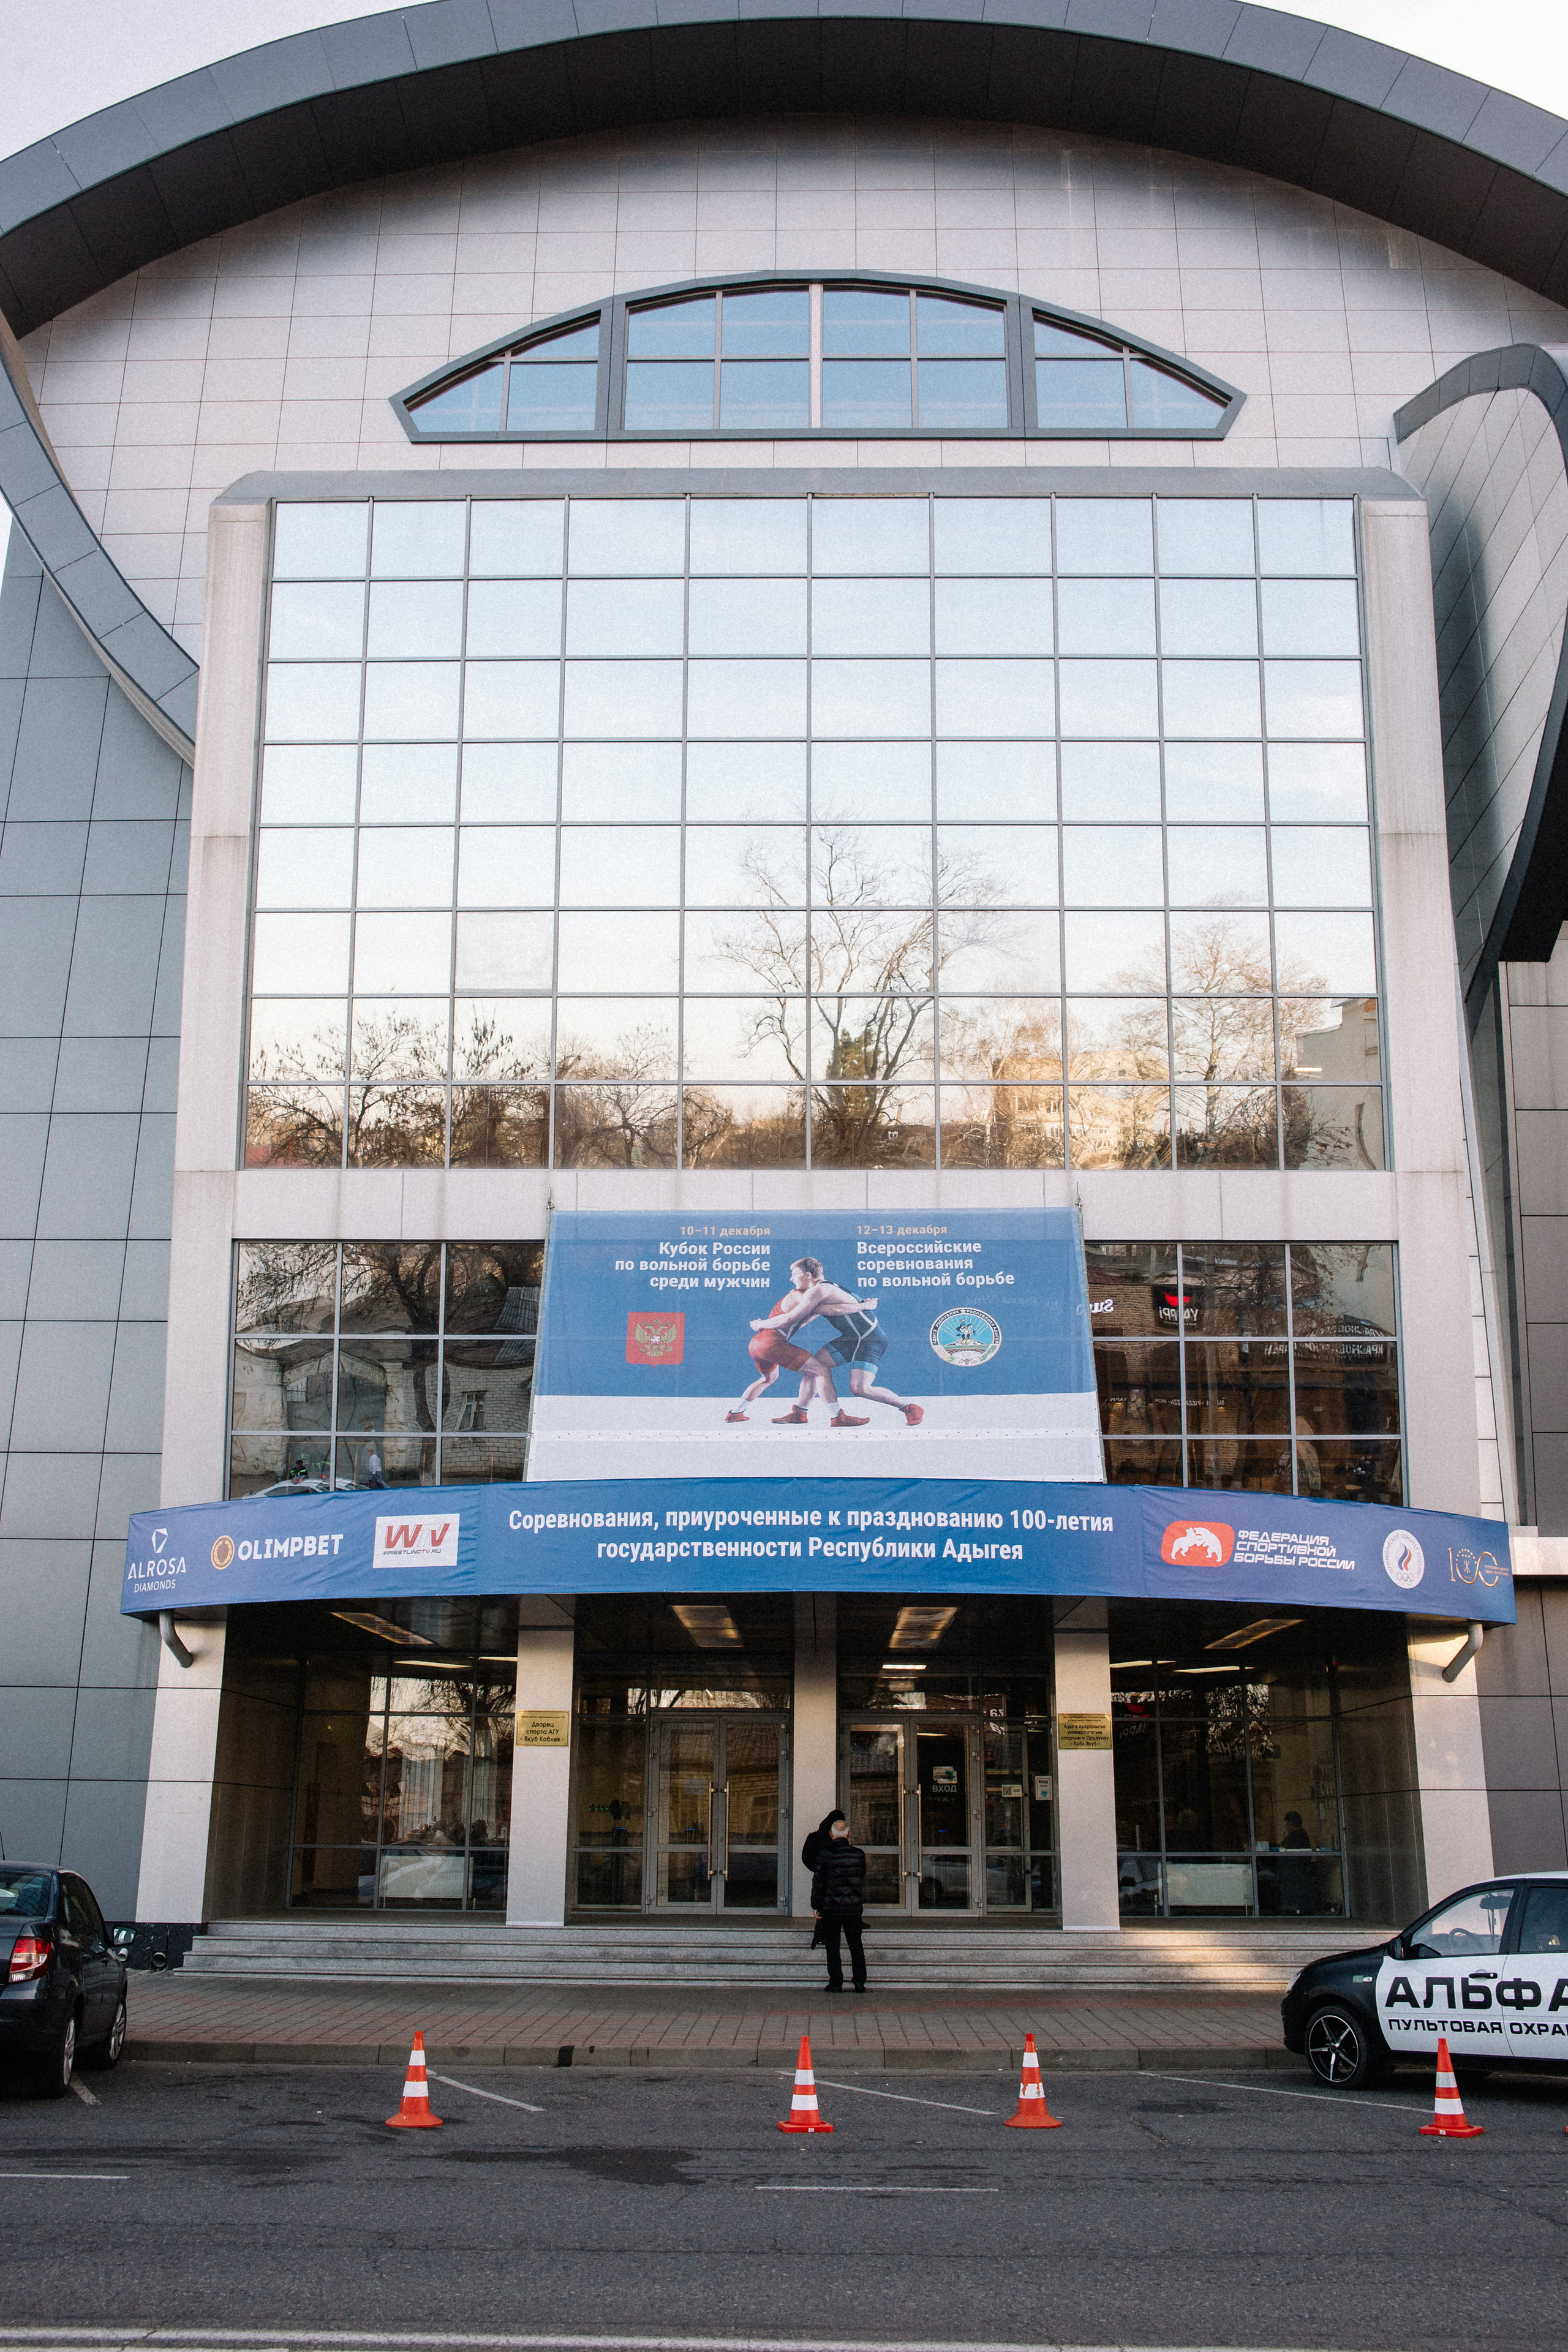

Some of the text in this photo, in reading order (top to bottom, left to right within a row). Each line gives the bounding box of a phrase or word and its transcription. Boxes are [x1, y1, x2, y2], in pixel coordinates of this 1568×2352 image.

[720, 1225, 771, 1237] декабря
[897, 1224, 948, 1236] декабря
[659, 1241, 771, 1257] Кубок России
[857, 1240, 982, 1256] Всероссийские
[615, 1257, 771, 1274] по вольной борьбе
[857, 1259, 973, 1273] соревнования
[650, 1276, 770, 1291] среди мужчин
[858, 1271, 1015, 1289] по вольной борьбе
[966, 1310, 995, 1327] РЕСПУБЛИКА
[509, 1509, 1114, 1534] Соревнования, приуроченные к празднованию 100-летия
[1238, 1530, 1329, 1546] ФЕДЕРАЦИЯ
[238, 1534, 344, 1561] OLIMPBET
[597, 1537, 1023, 1562] государственности Республики Адыгея
[1236, 1541, 1336, 1558] СПОРТИВНОЙ
[1385, 1533, 1400, 1574] ОЛИМПИЙСКИЙ
[1401, 1533, 1419, 1550] КОМИТЕТ
[127, 1556, 186, 1580] ALROSA
[1234, 1552, 1355, 1570] БОРЬБЫ РОССИИ
[134, 1578, 176, 1593] DIAMONDS
[1388, 2019, 1568, 2037] ПУЛЬТОВАЯ ОХРА
